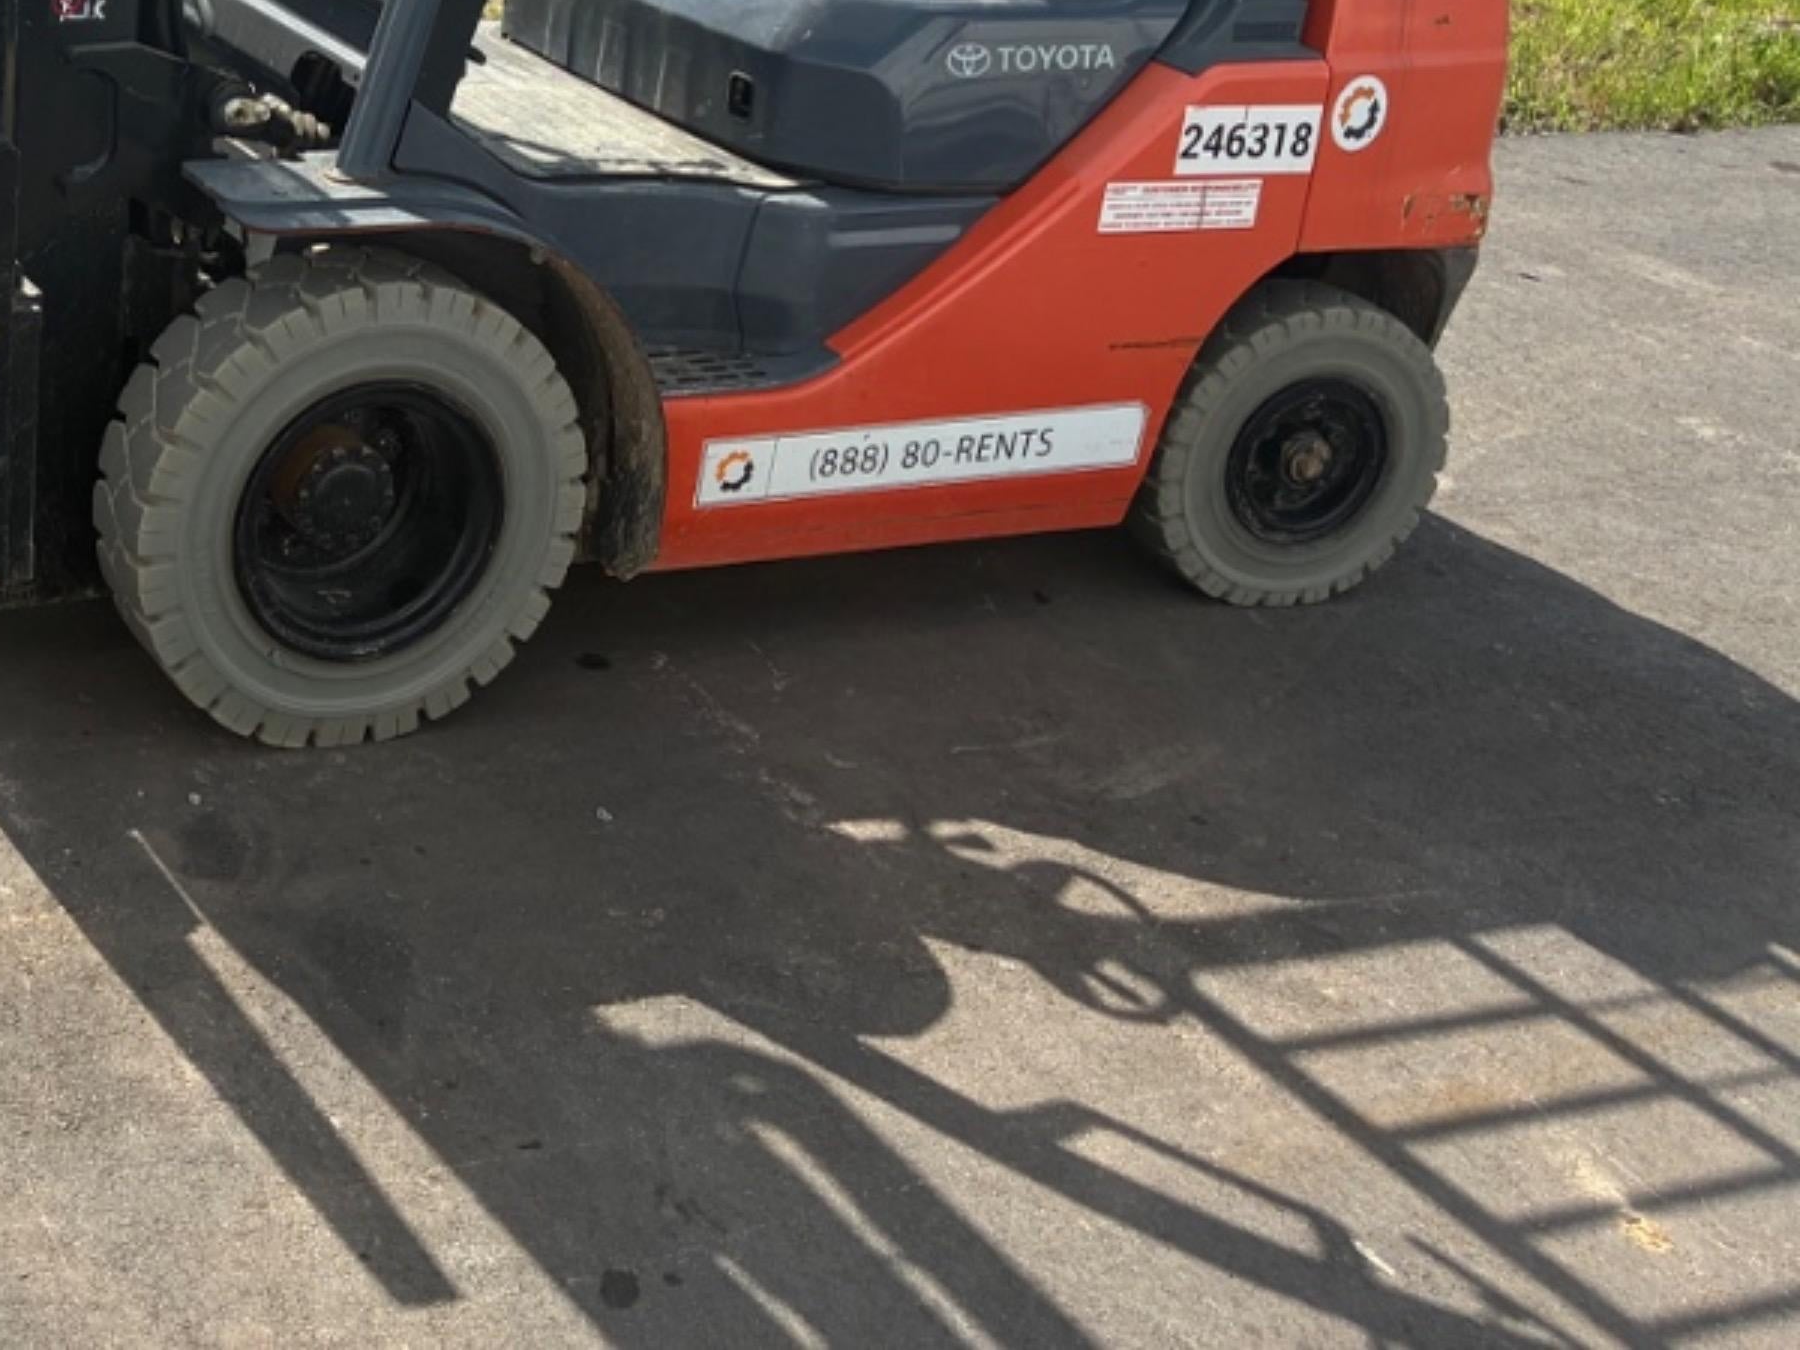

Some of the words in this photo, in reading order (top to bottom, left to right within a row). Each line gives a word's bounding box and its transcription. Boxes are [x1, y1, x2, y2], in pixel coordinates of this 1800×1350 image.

[997, 44, 1115, 73] TOYOTA
[1178, 121, 1313, 160] 246318
[809, 442, 890, 481] (888)
[901, 428, 1055, 470] 80-RENTS
